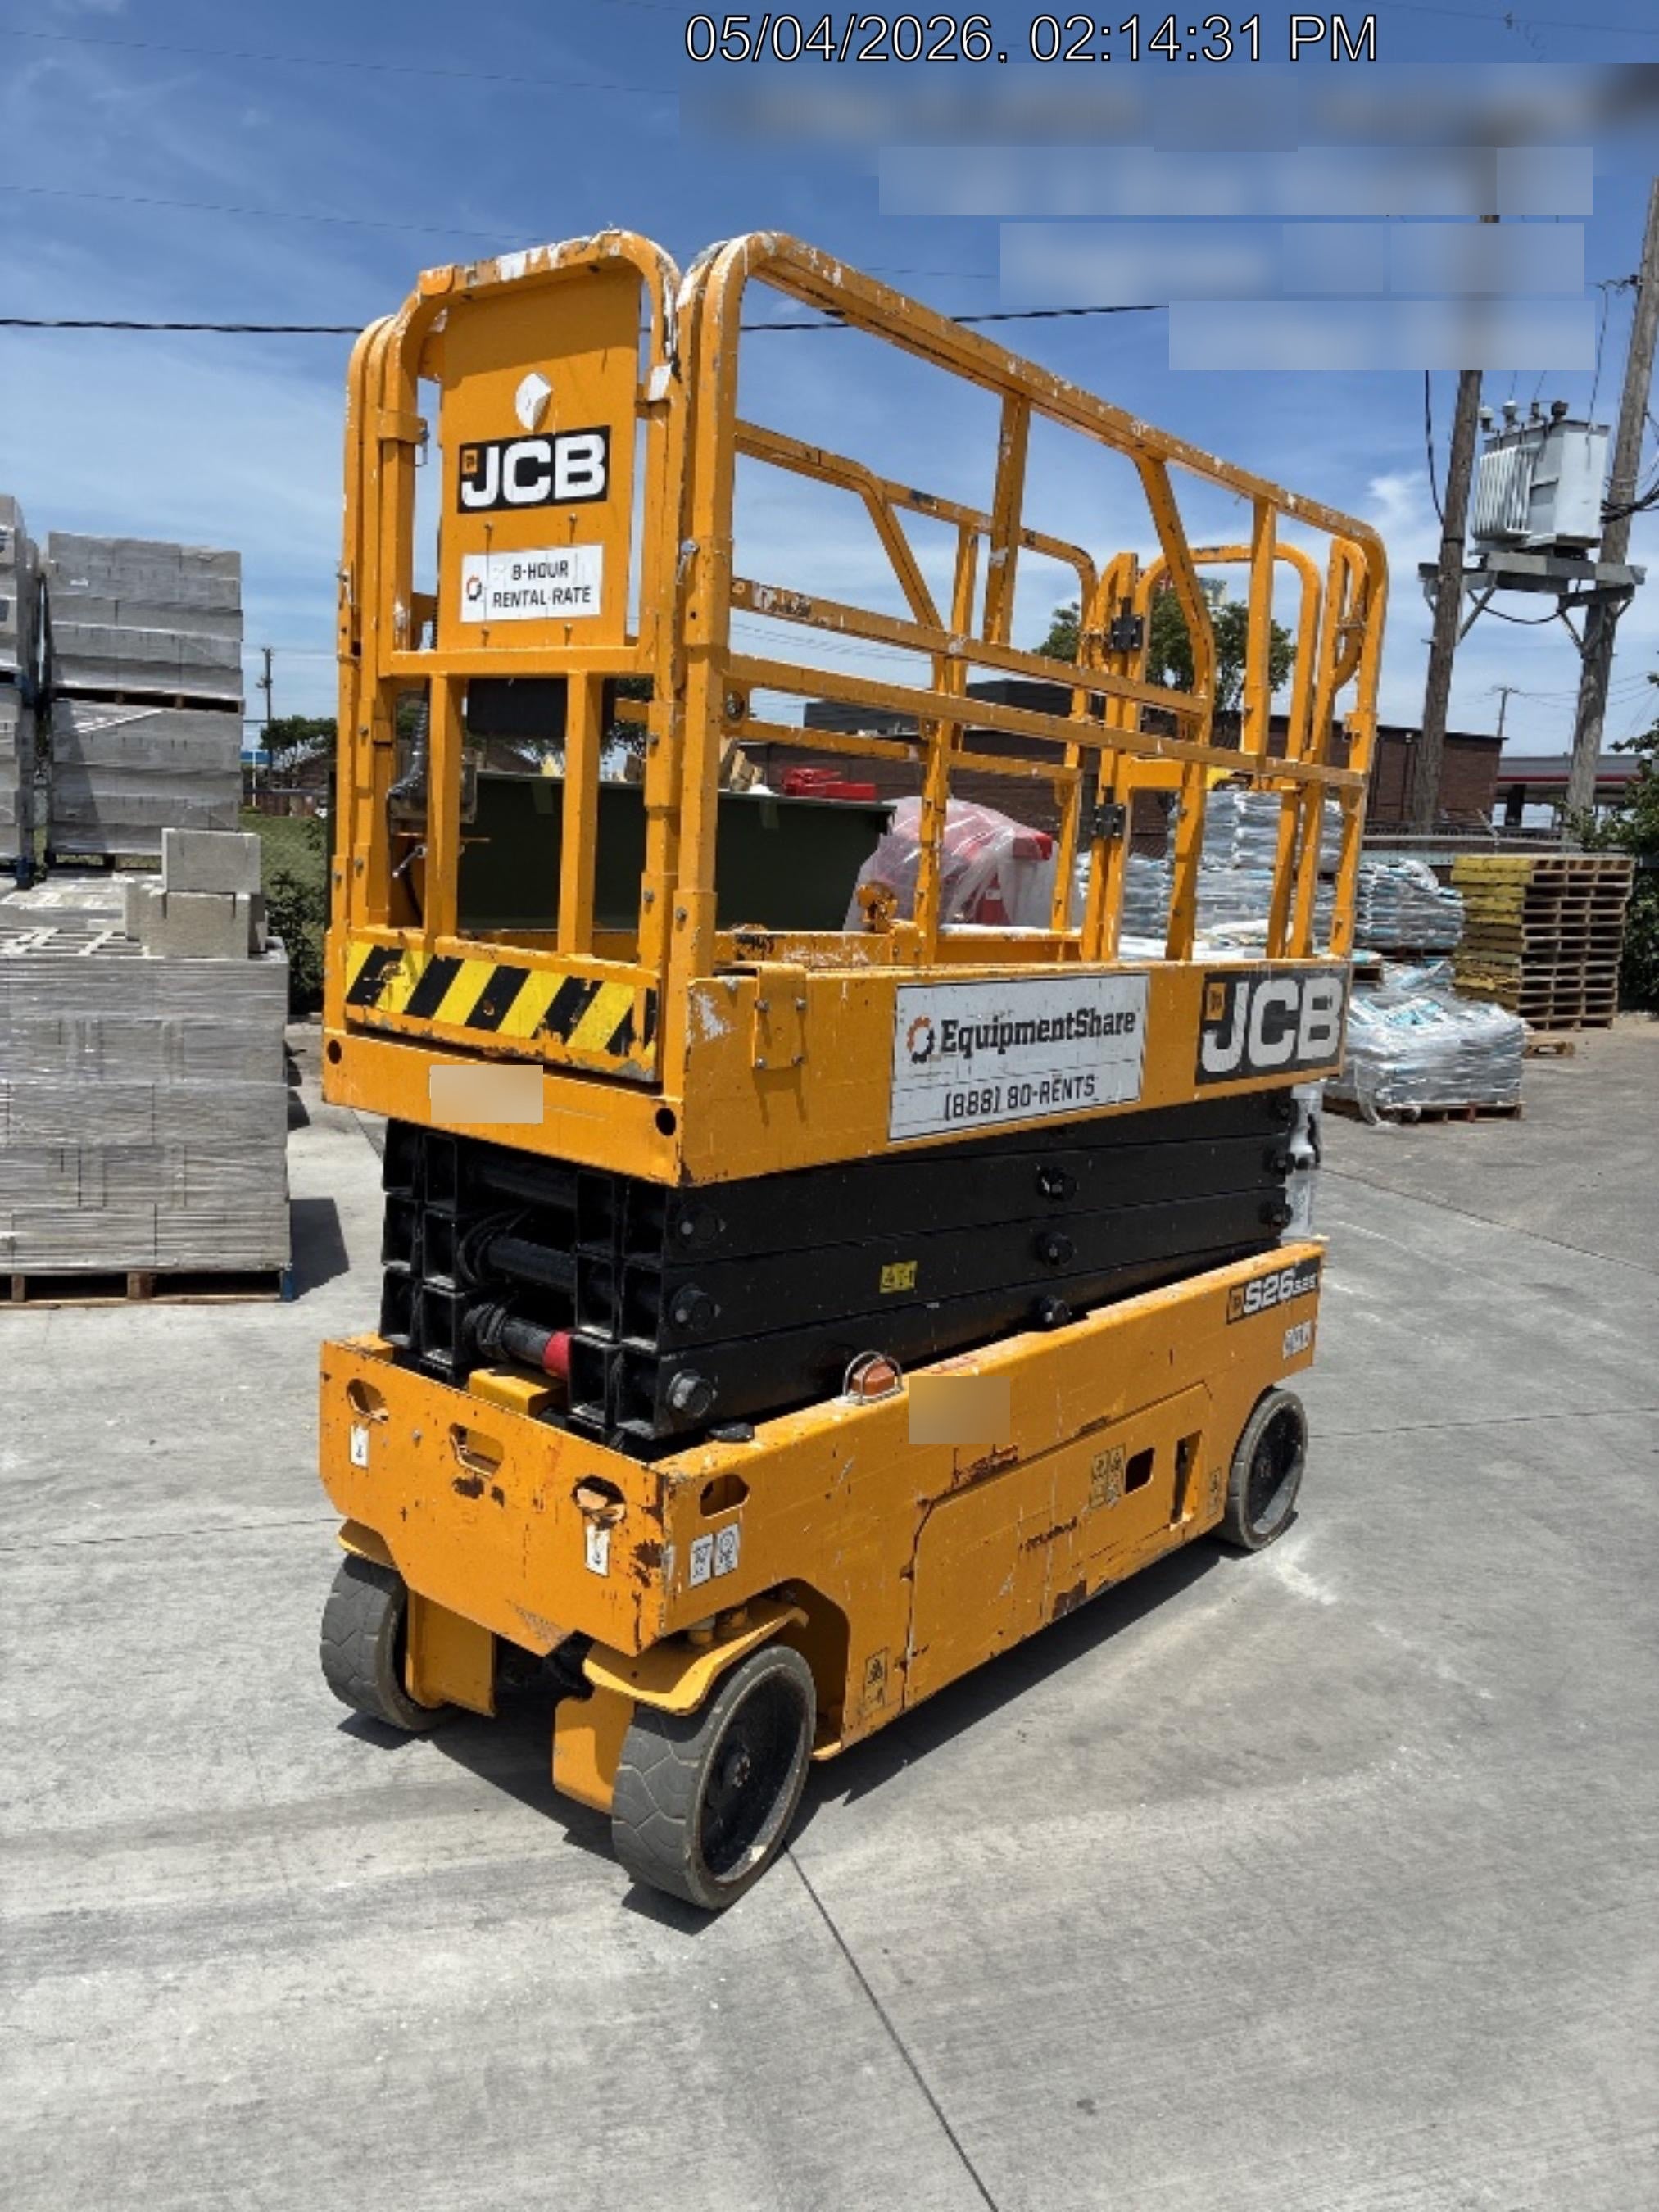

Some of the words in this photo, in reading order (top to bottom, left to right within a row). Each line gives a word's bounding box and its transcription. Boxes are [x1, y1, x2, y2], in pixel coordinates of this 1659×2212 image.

[461, 433, 605, 507] JCB
[512, 560, 569, 580] 8-HOUR
[492, 593, 546, 608] RENTAL
[551, 586, 591, 604] RATE
[941, 1007, 1135, 1059] EquipmentShare
[1200, 978, 1341, 1072] JCB
[1007, 1074, 1095, 1108] 80-RENTS
